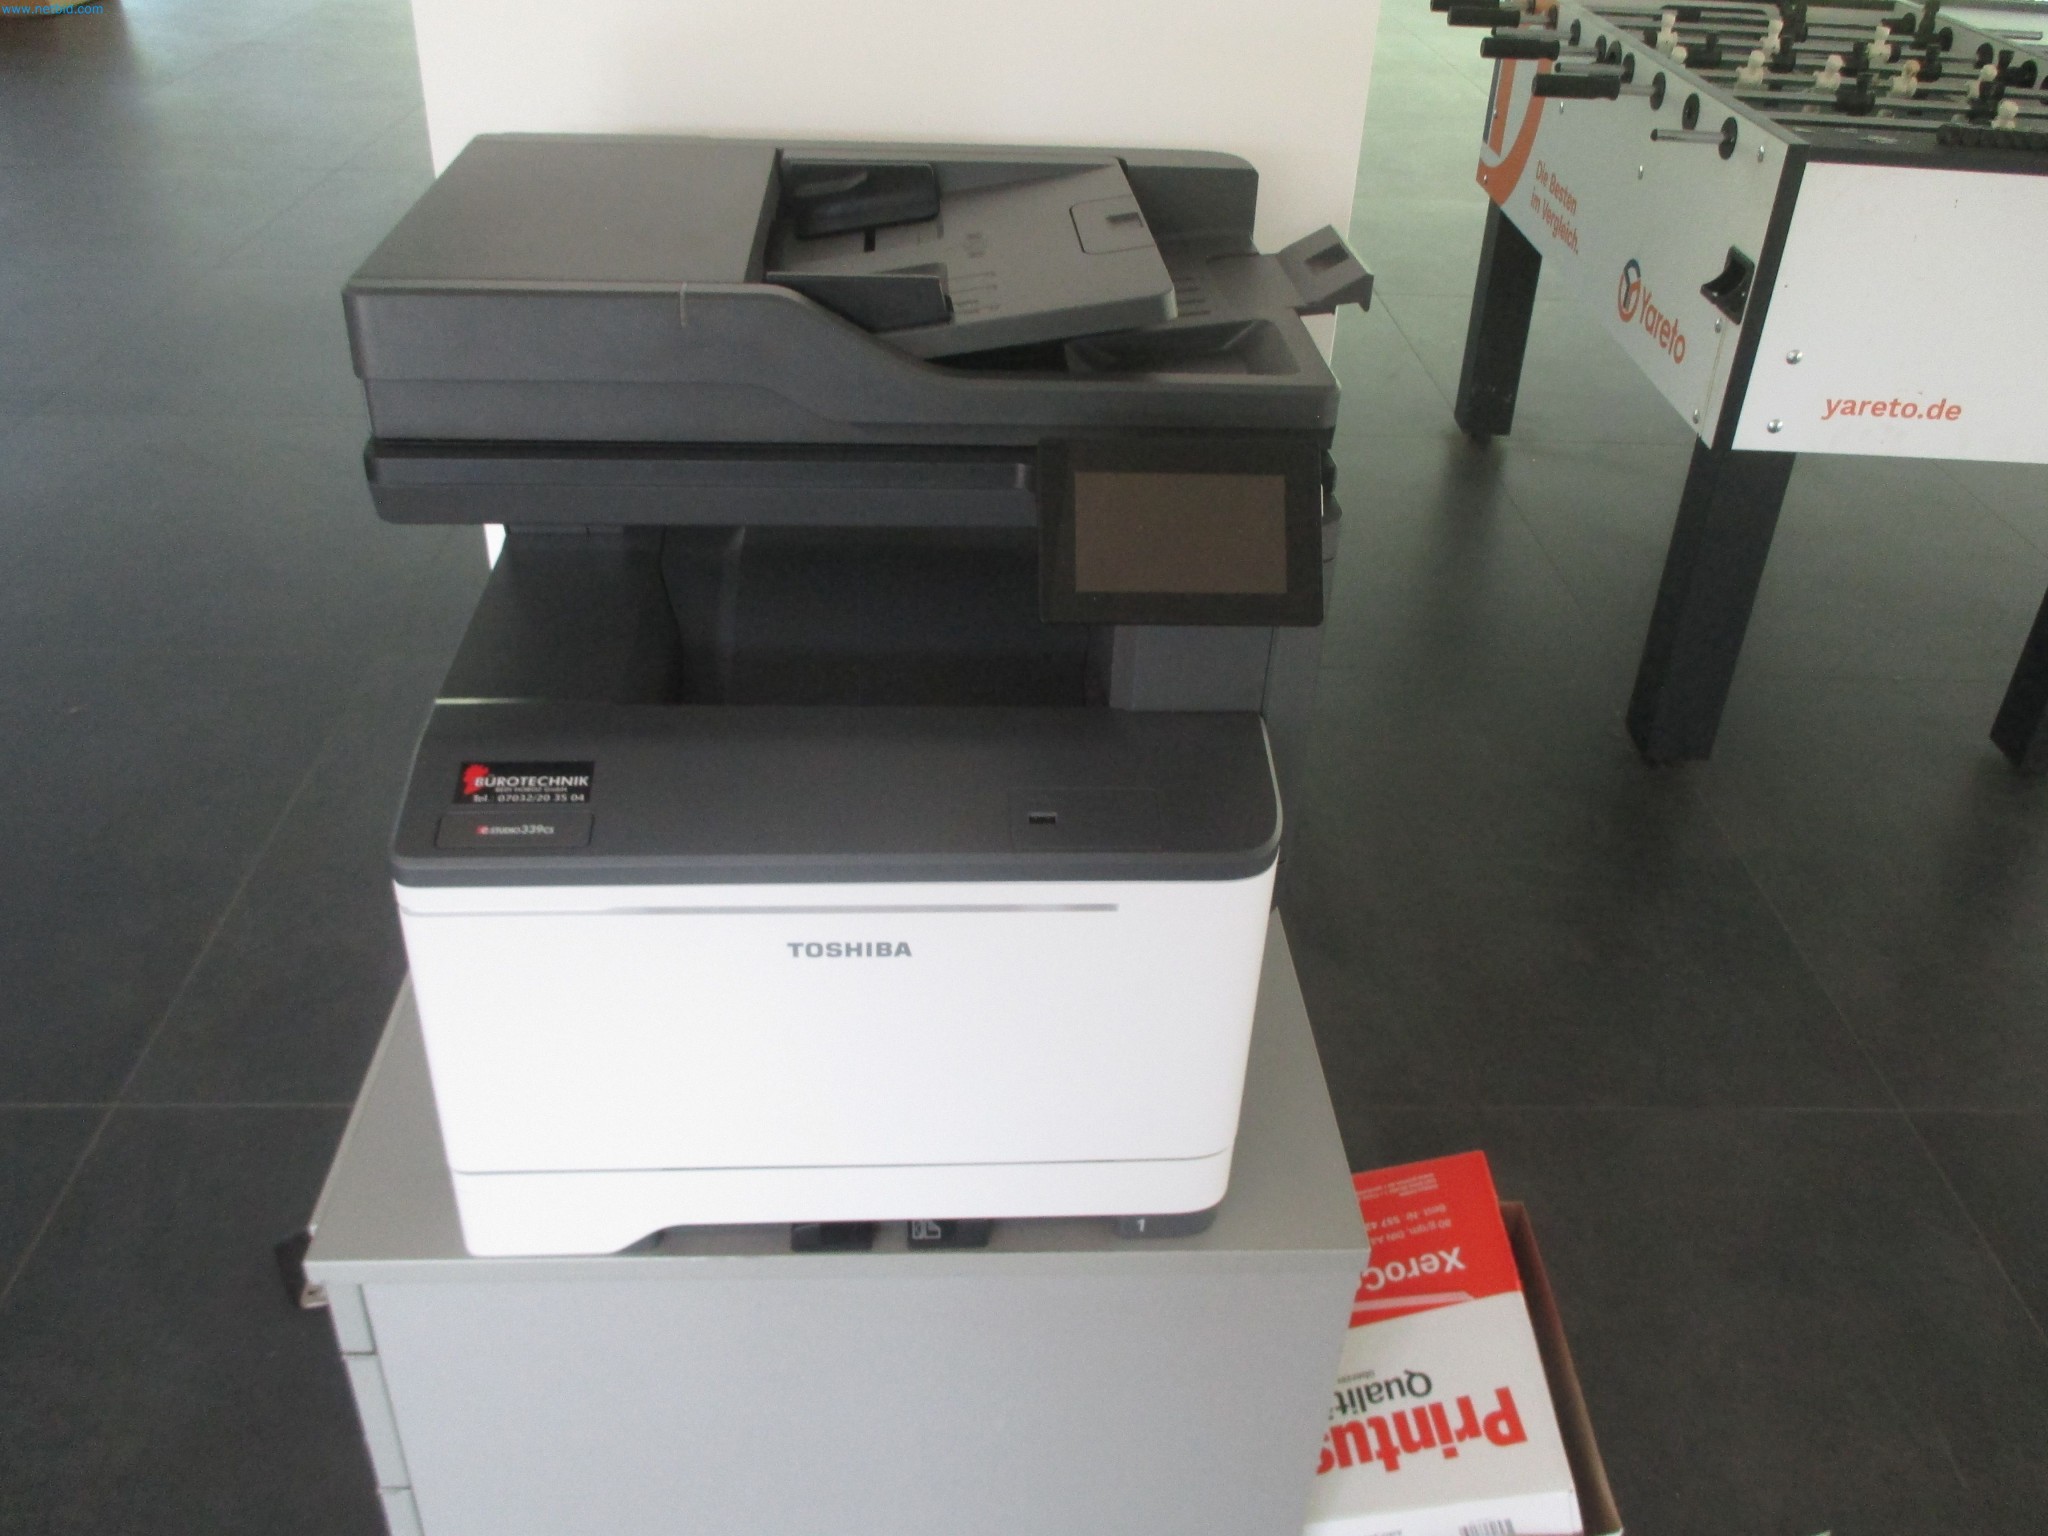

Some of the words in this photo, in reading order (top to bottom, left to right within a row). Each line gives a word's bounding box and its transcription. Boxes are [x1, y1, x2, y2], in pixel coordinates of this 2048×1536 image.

[1536, 160, 1549, 188] Die
[1550, 173, 1577, 216] Besten
[1530, 187, 1541, 214] im
[1543, 199, 1578, 255] Vergleich.
[1640, 286, 1686, 364] Yareto
[1821, 398, 1962, 422] yareto.de
[475, 775, 589, 787] BÜROTECHNIK
[787, 942, 912, 958] TOSHIBA
[1136, 1218, 1146, 1232] 1
[1359, 1246, 1467, 1291] XeroC
[1328, 1368, 1433, 1421] Qualit
